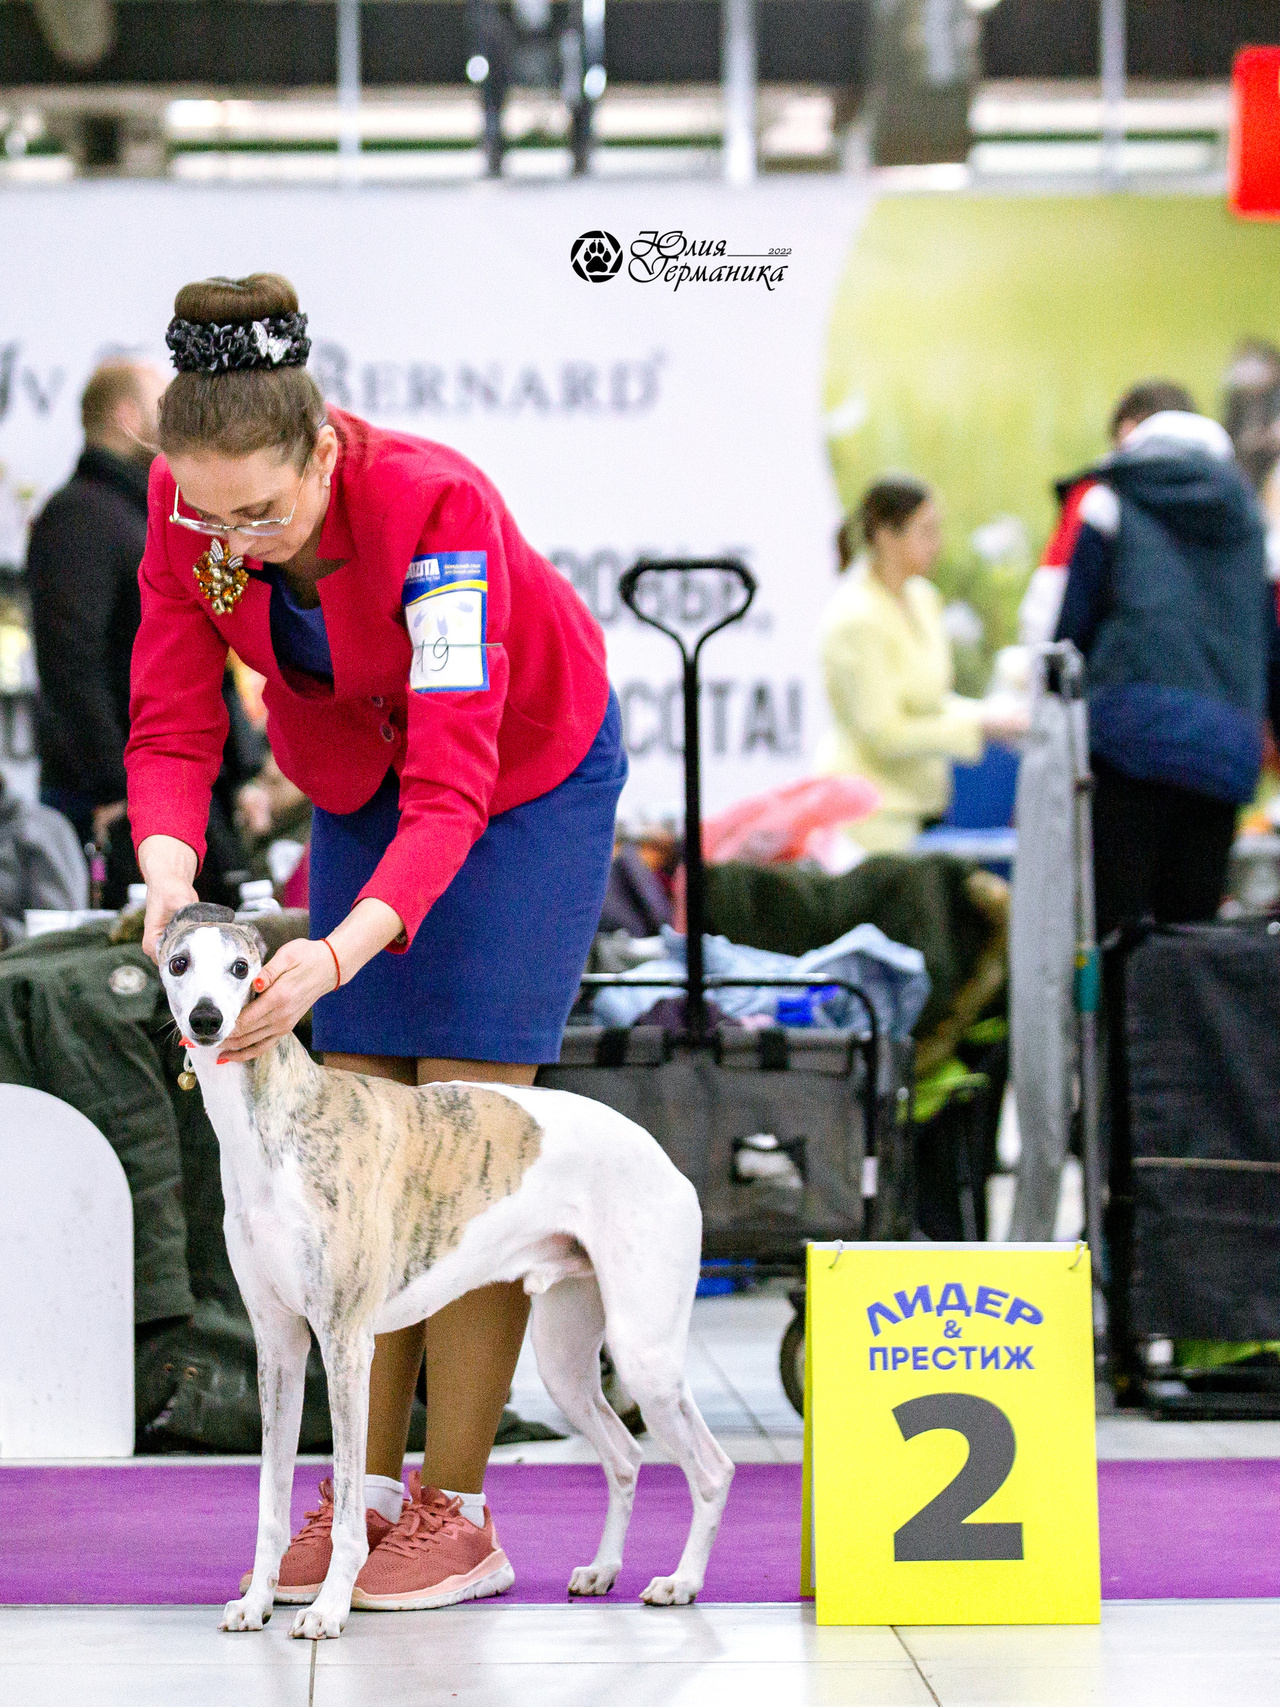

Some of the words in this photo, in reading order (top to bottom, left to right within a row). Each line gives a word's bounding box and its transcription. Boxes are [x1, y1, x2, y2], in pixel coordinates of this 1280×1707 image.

[416, 636, 449, 673] 19
[867, 1283, 1044, 1337] ЛИДЕР
[944, 1320, 963, 1339] &
[869, 1346, 1035, 1371] ПРЕСТИЖ
[892, 1393, 1025, 1562] 2
